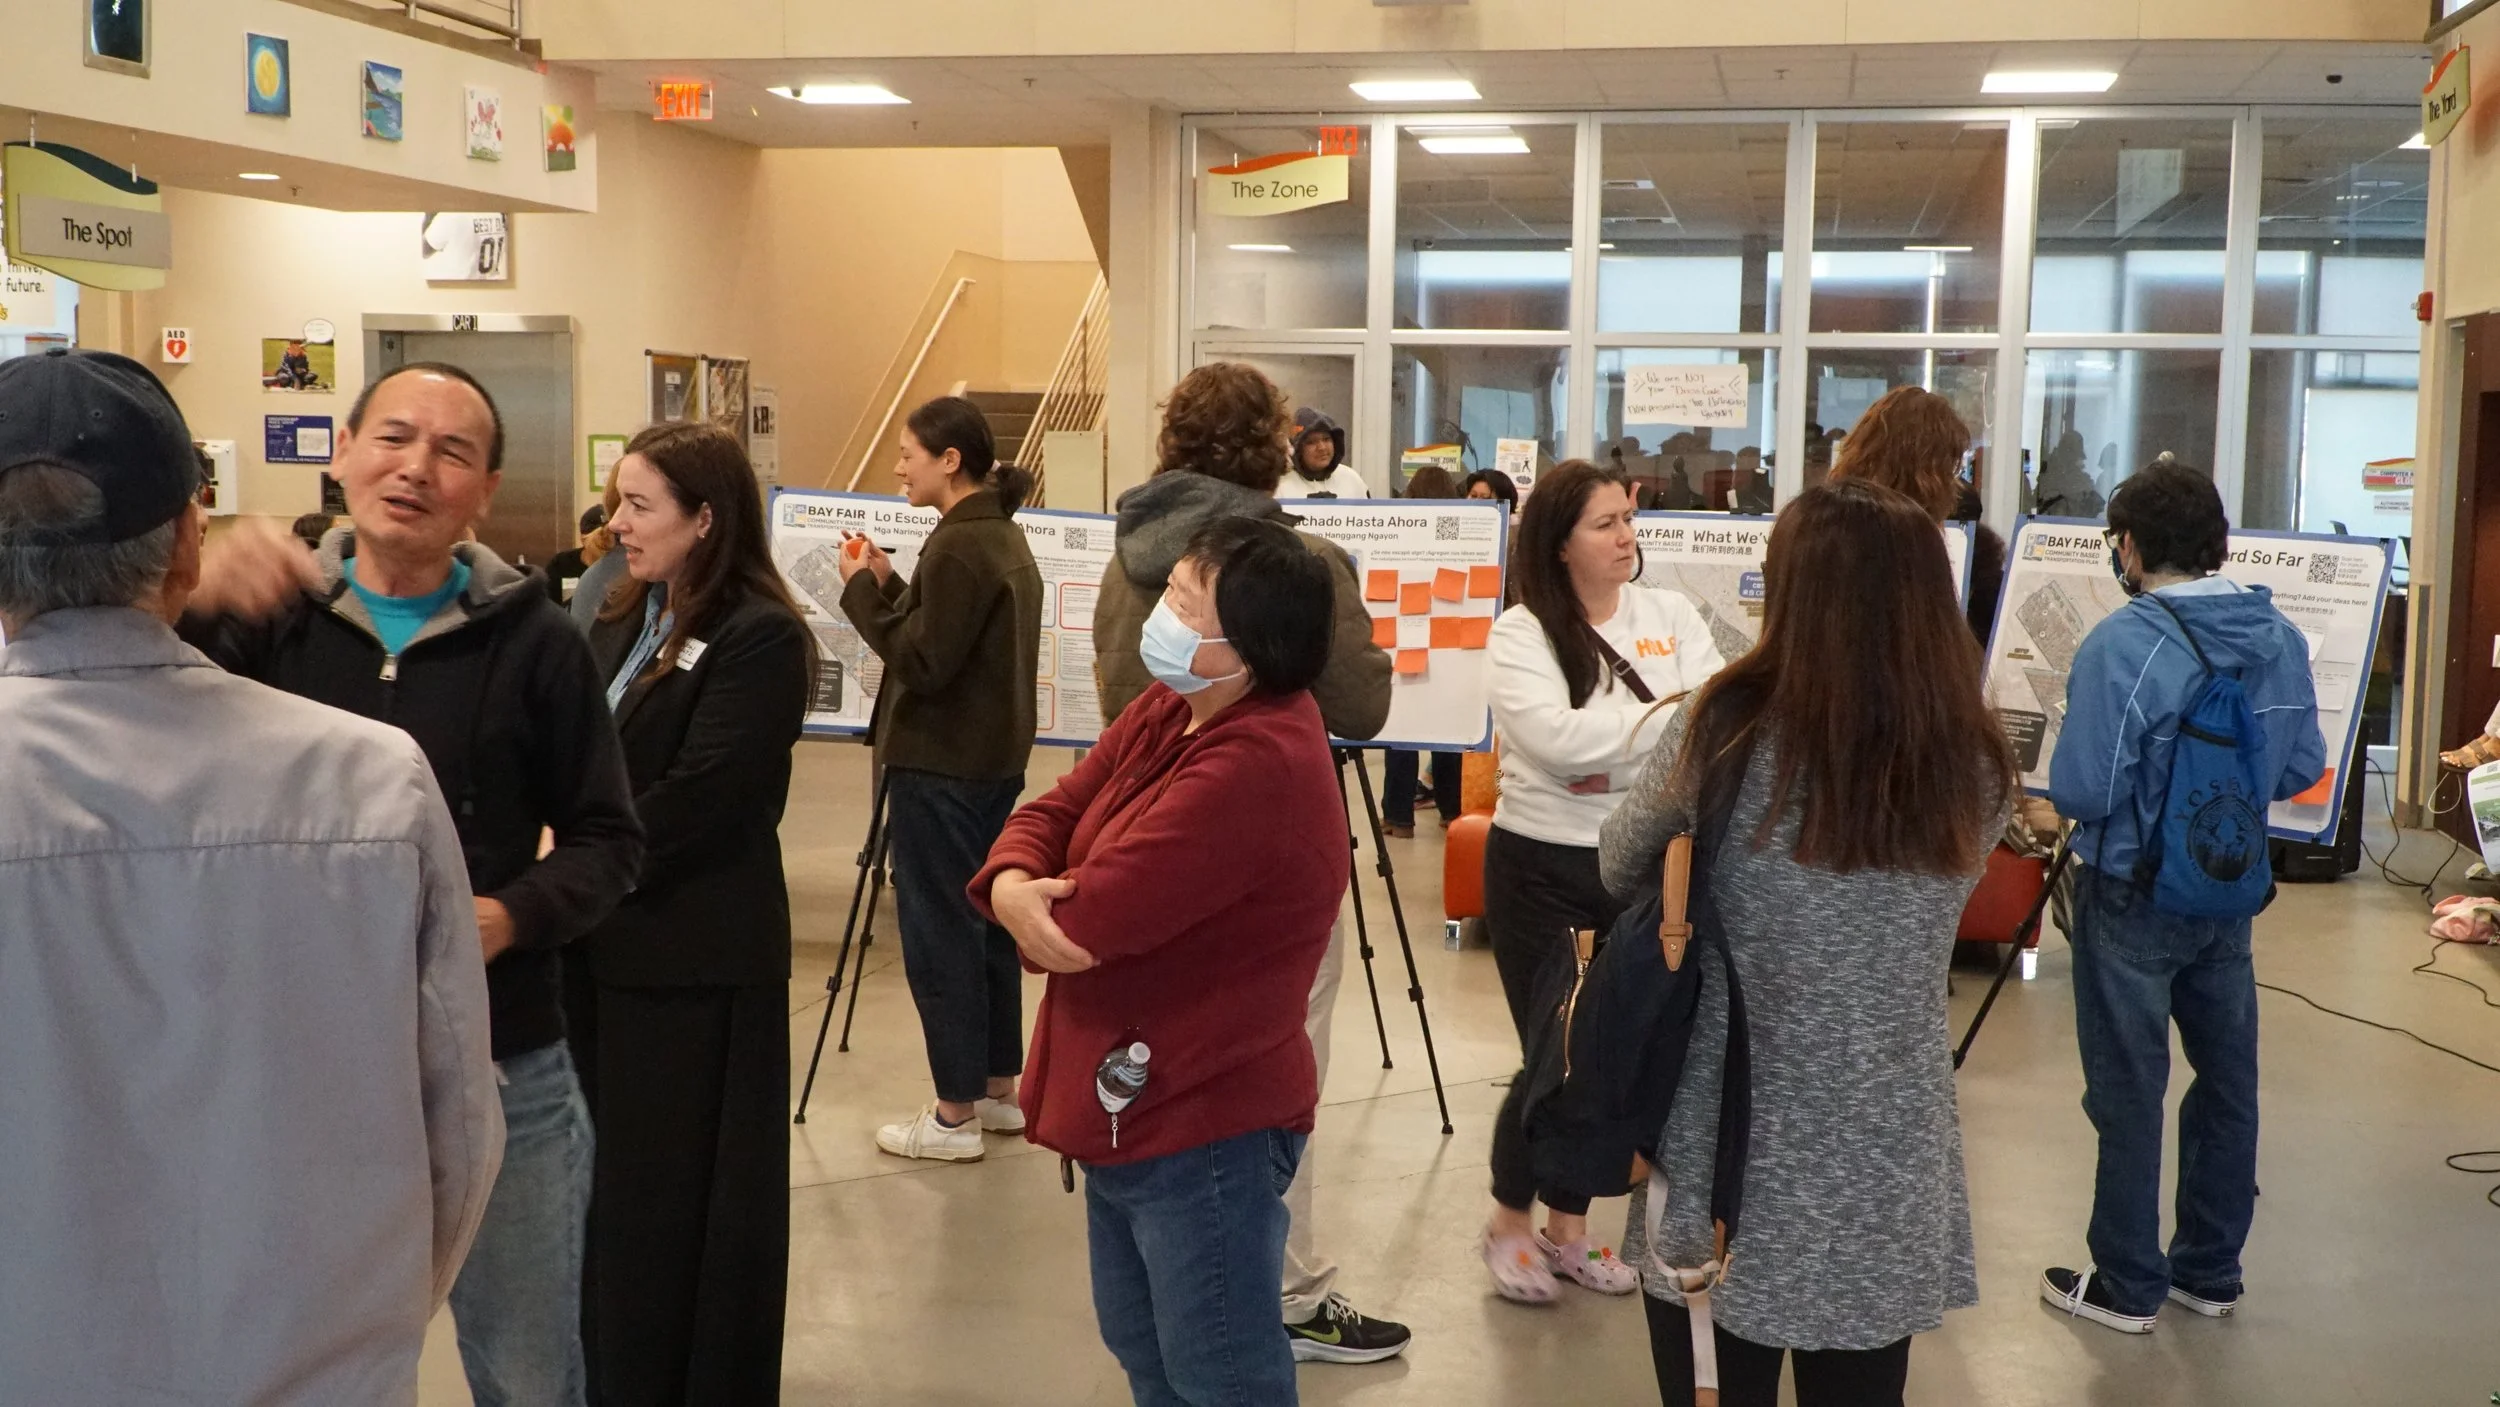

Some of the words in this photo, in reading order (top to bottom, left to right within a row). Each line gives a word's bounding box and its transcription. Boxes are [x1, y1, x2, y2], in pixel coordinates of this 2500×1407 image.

[662, 84, 703, 118] EXIT
[2429, 100, 2441, 123] The
[2441, 87, 2458, 116] Yard
[1231, 181, 1265, 199] The
[1271, 180, 1319, 199] Zone
[62, 217, 92, 243] The
[96, 221, 133, 251] Spot
[6, 277, 45, 293] future.
[453, 315, 470, 331] CAR
[167, 330, 185, 339] AED
[808, 505, 833, 517] BAY
[836, 508, 866, 520] FAIR
[875, 511, 892, 523] Lo
[1346, 516, 1385, 528] Hasta
[1388, 516, 1428, 528] Ahora
[873, 526, 892, 535] Mga
[893, 528, 923, 538] Narinig
[1325, 532, 1367, 541] Hanggang
[1367, 532, 1399, 541] Ngayon
[1637, 528, 1653, 539] AY
[1655, 528, 1685, 539] FAIR
[1693, 530, 1732, 544] What
[1692, 544, 1753, 556] 我们听到的消息
[2047, 535, 2073, 548] BAY
[2073, 538, 2102, 551] FAIR
[2251, 550, 2272, 565] So
[2276, 552, 2305, 568] Far
[2333, 597, 2351, 605] ideas
